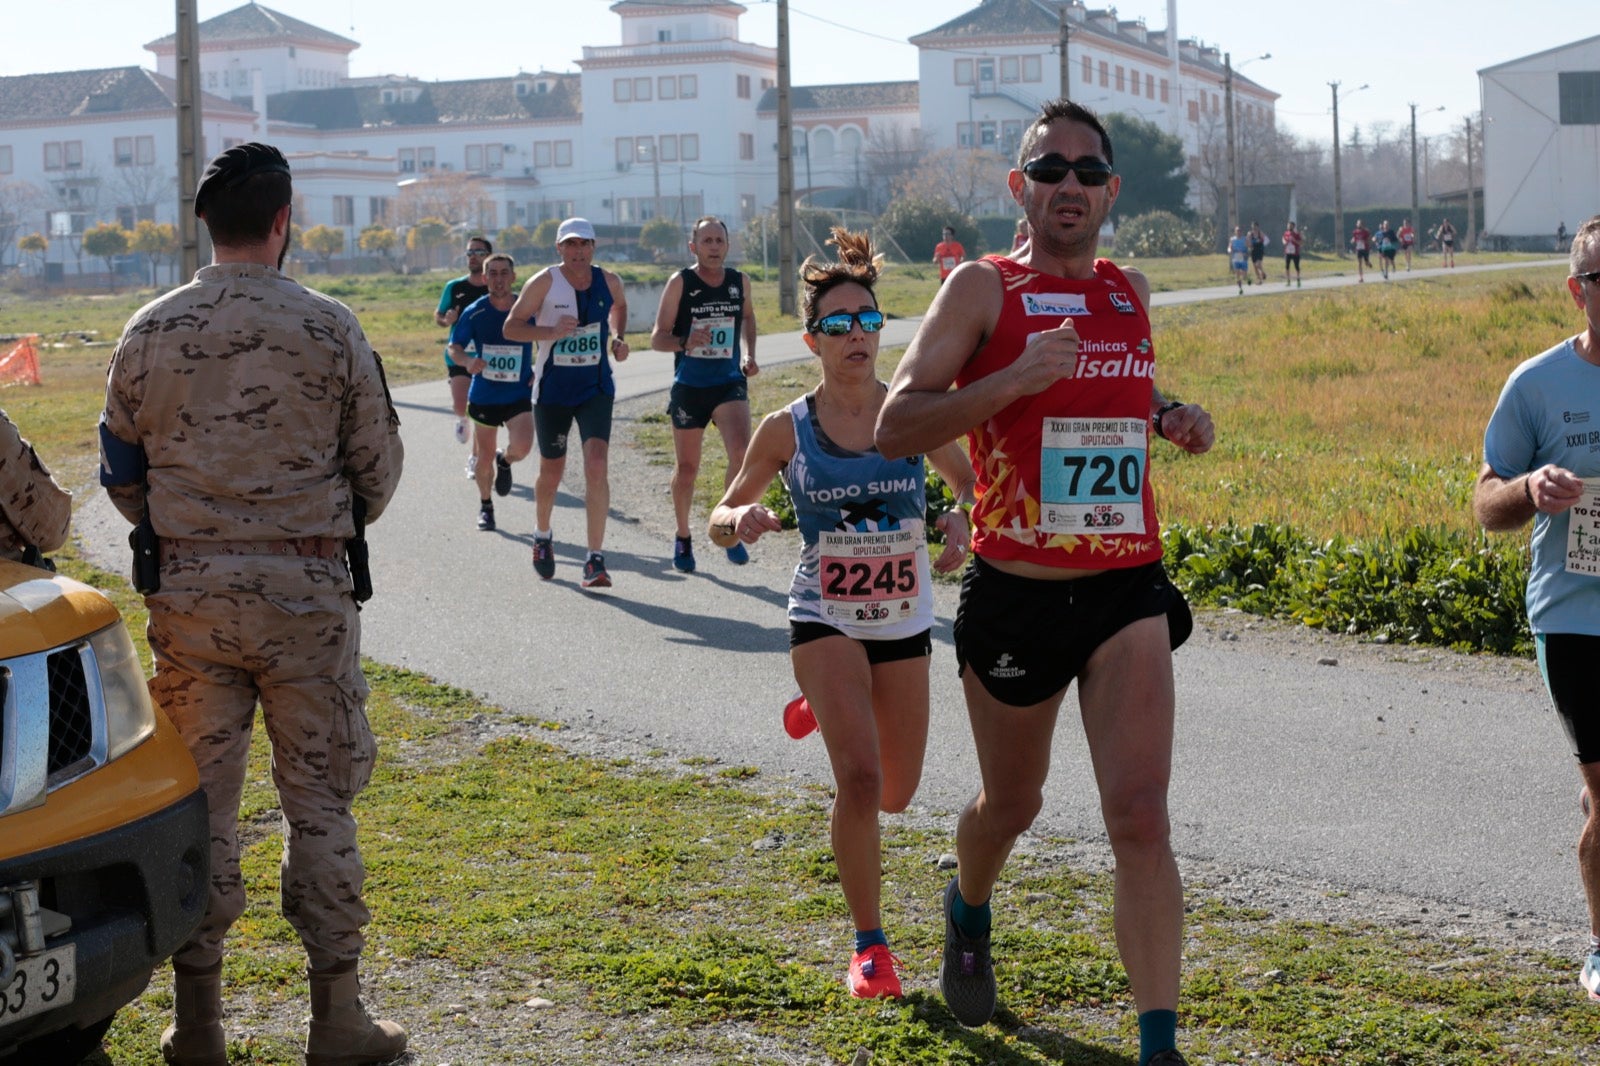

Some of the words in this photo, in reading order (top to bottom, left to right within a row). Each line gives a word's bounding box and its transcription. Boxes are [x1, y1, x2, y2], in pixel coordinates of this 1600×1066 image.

[488, 357, 516, 370] 400
[1073, 422, 1090, 433] GRAN
[1092, 422, 1118, 433] PREMIO
[1119, 422, 1129, 433] DE
[1081, 434, 1124, 446] DIPUTACIÓN
[1063, 454, 1140, 496] 720
[806, 484, 861, 504] TODO
[867, 477, 917, 495] SUMA
[1574, 507, 1587, 516] YO
[844, 535, 862, 545] GRAN
[863, 534, 887, 545] PREMIO
[888, 534, 895, 544] DE
[853, 545, 891, 556] DIPUTACIÓN
[826, 559, 916, 597] 2245
